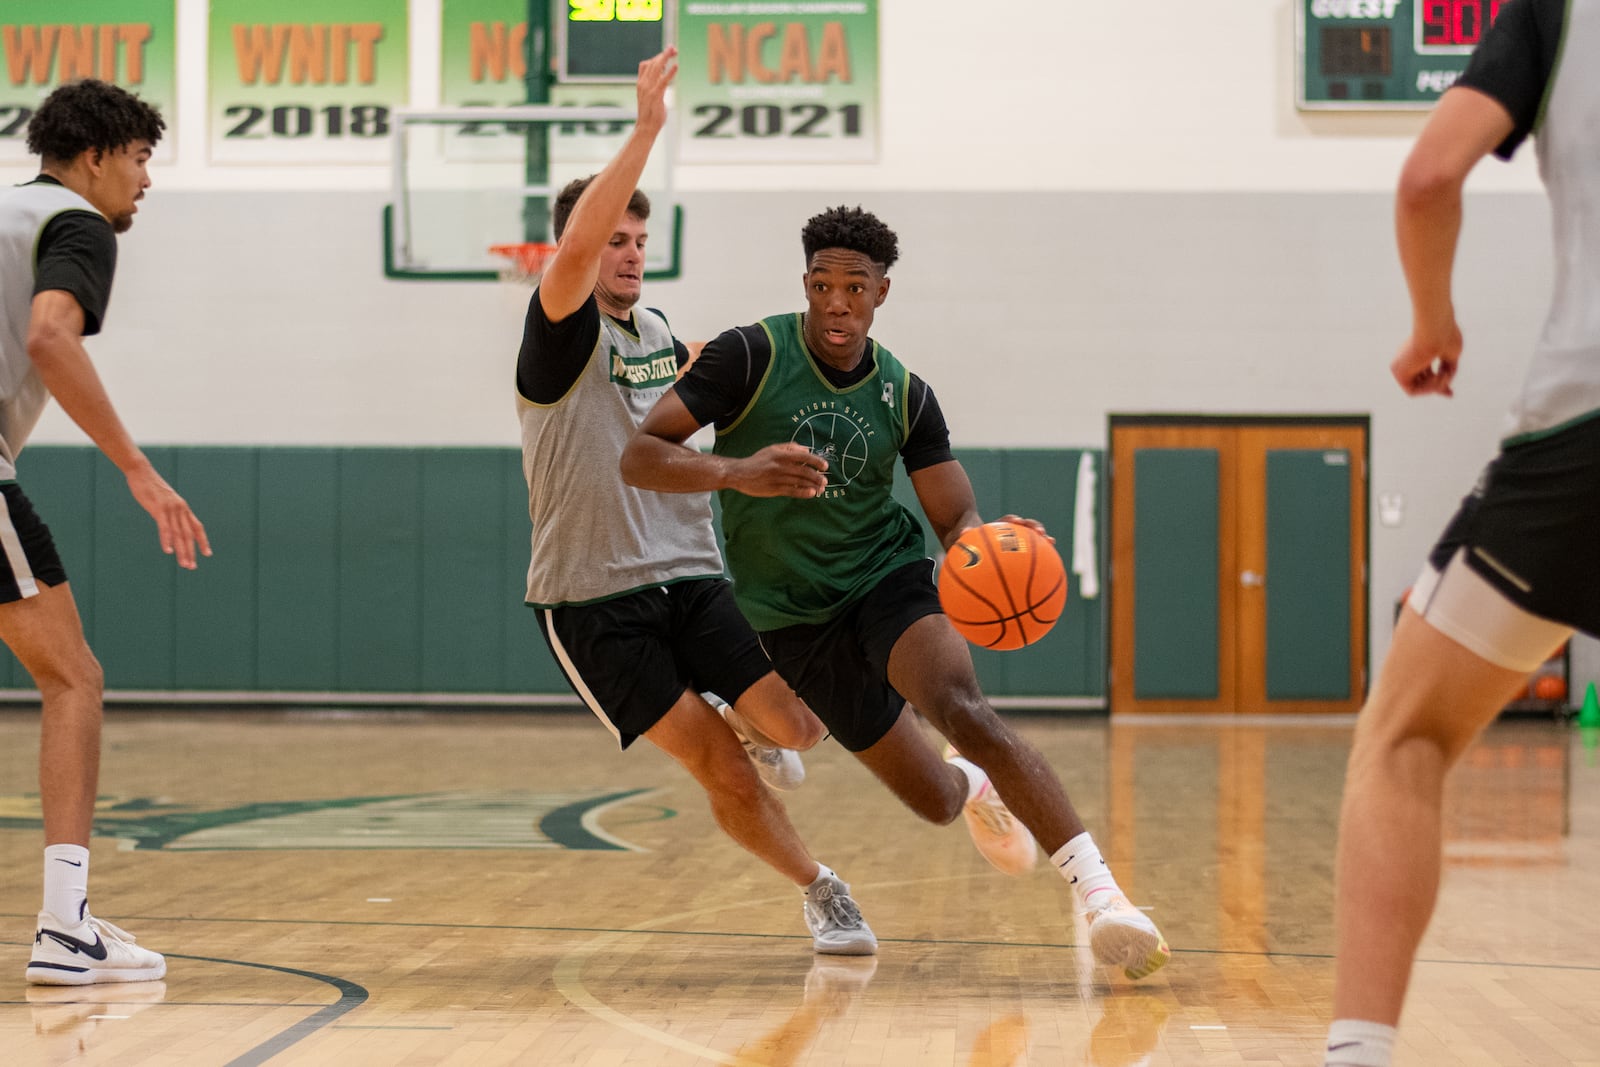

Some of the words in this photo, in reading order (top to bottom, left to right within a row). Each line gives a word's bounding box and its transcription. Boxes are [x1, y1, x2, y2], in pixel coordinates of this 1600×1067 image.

[1311, 0, 1398, 18] GUEST
[2, 22, 153, 86] WNIT
[231, 22, 383, 86] WNIT
[706, 21, 854, 85] NCAA
[224, 104, 391, 139] 2018
[692, 103, 863, 139] 2021
[791, 401, 836, 424] WRIGHT
[843, 405, 875, 438] STATE
